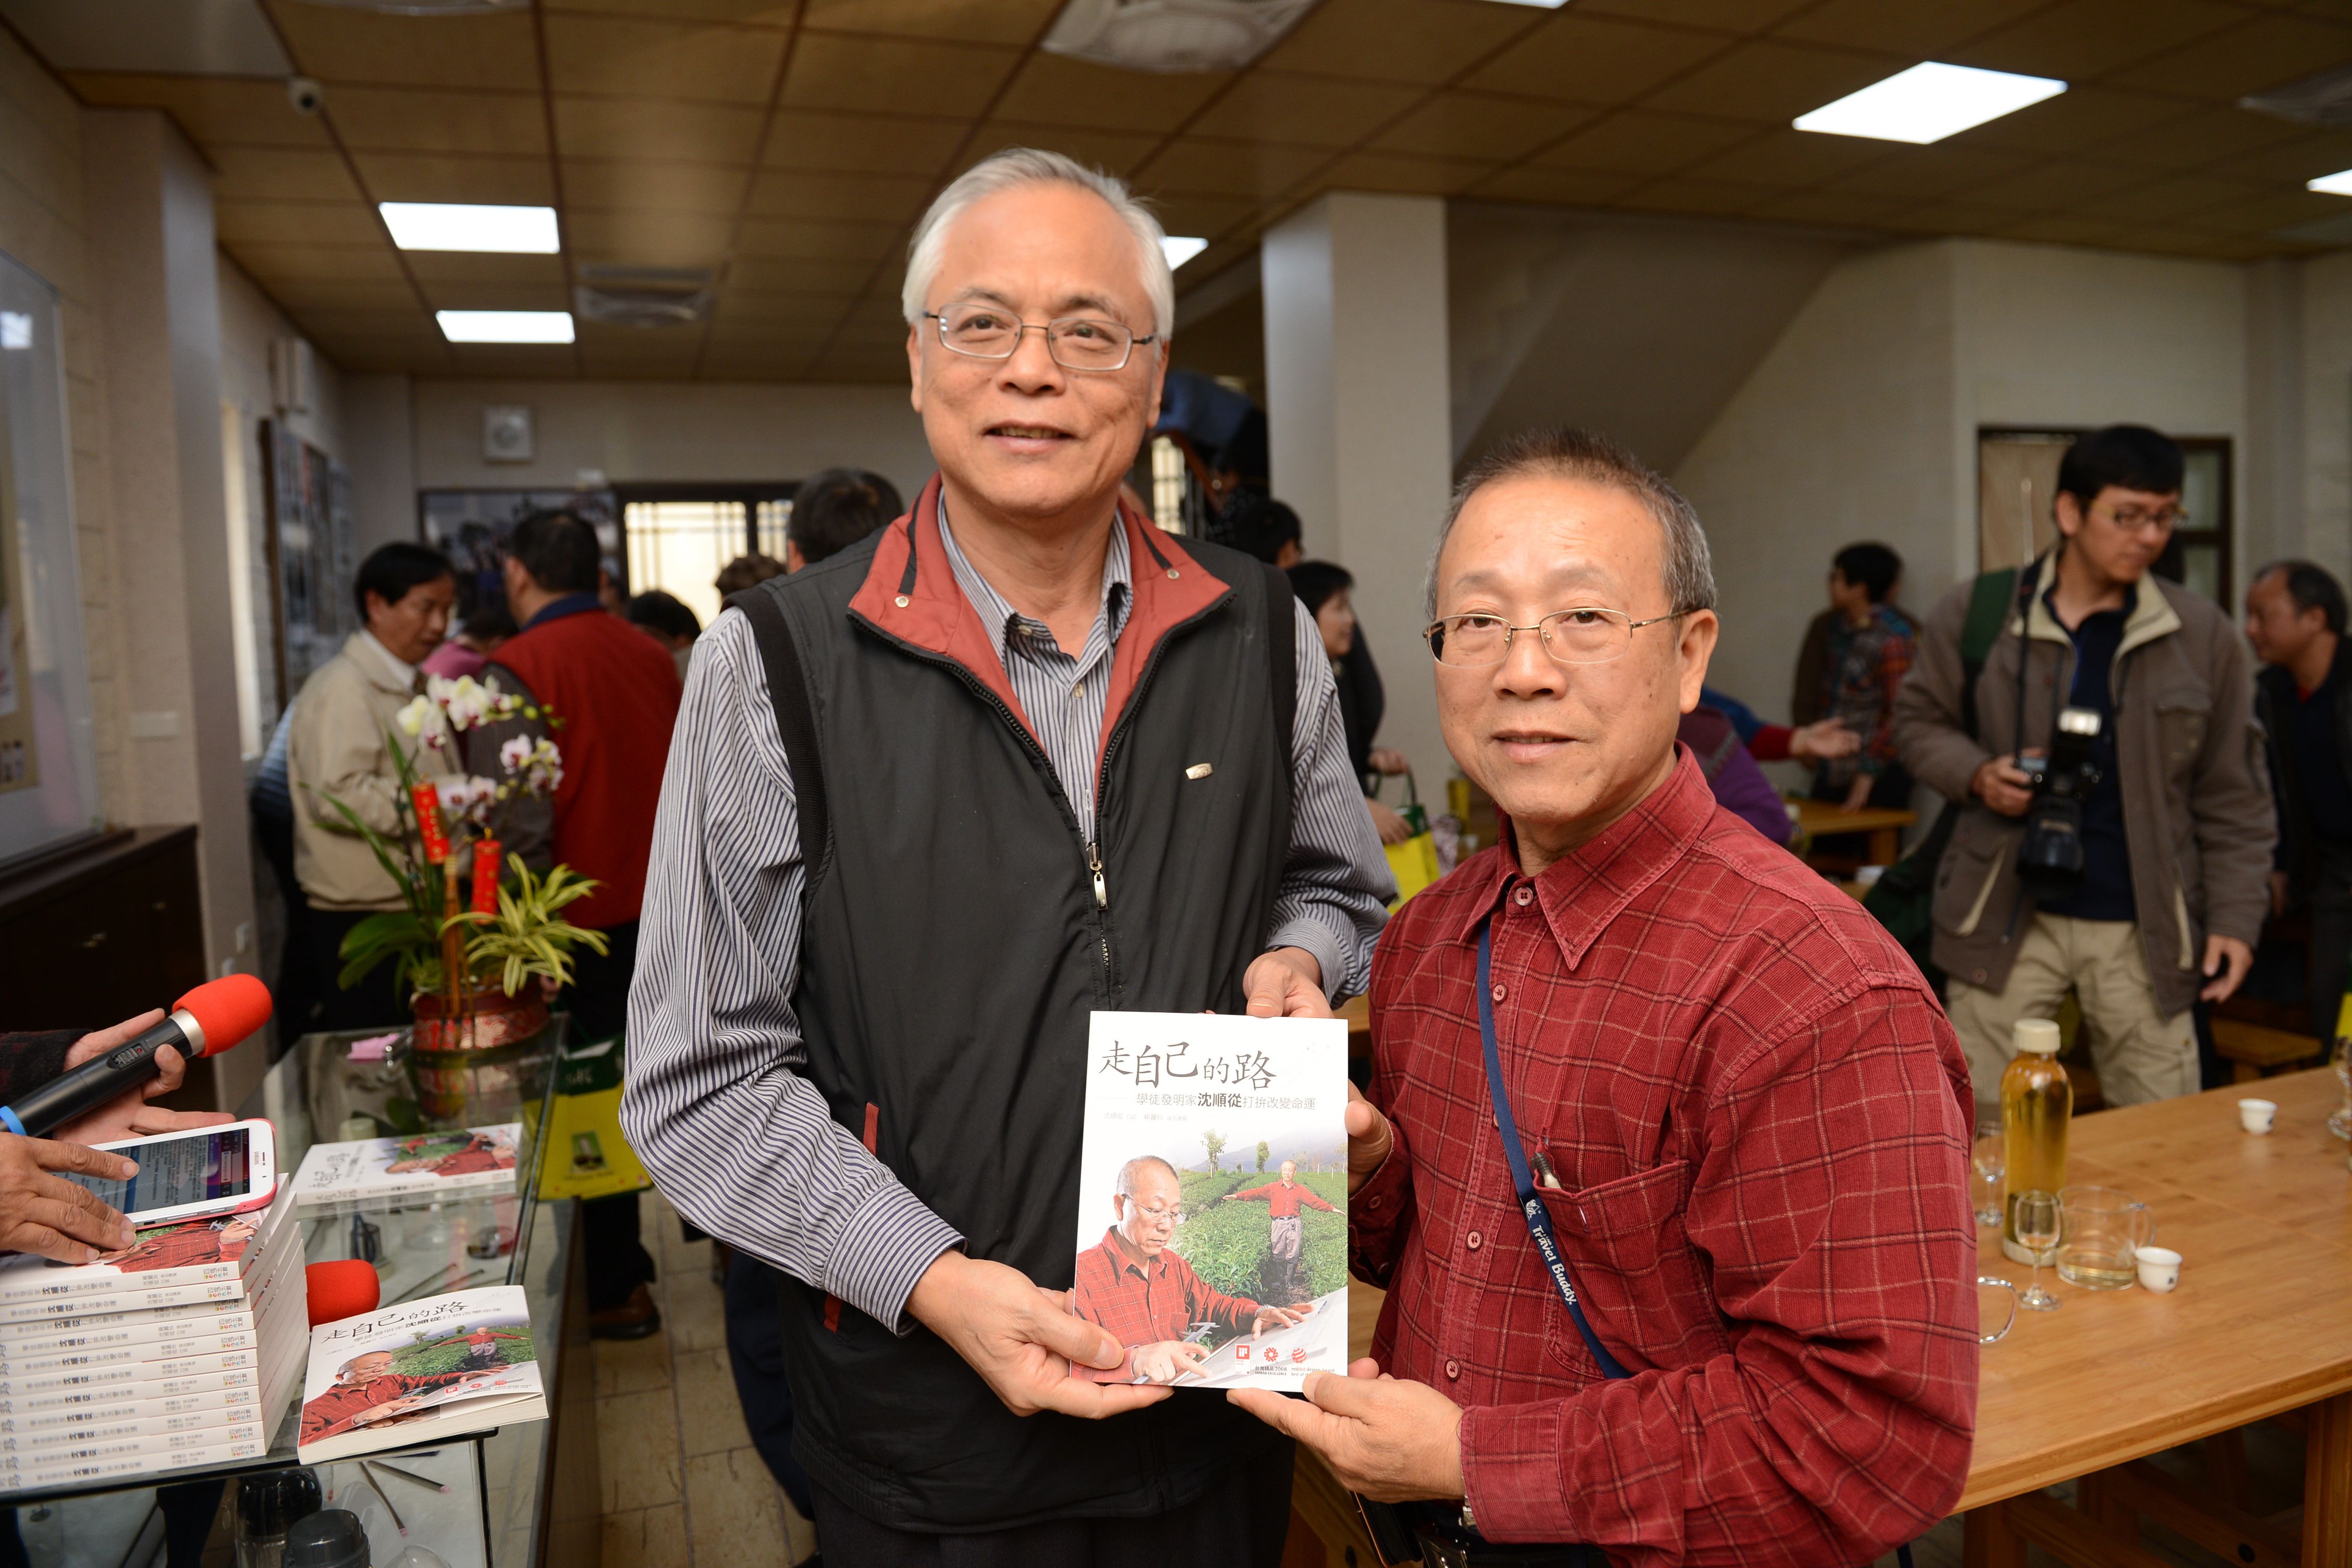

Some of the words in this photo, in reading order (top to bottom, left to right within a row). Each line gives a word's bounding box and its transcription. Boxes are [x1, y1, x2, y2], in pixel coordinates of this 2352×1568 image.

[1099, 1040, 1277, 1091] 走自己的路
[1533, 1225, 1557, 1261] Travel
[321, 1301, 469, 1344] 走自己的路
